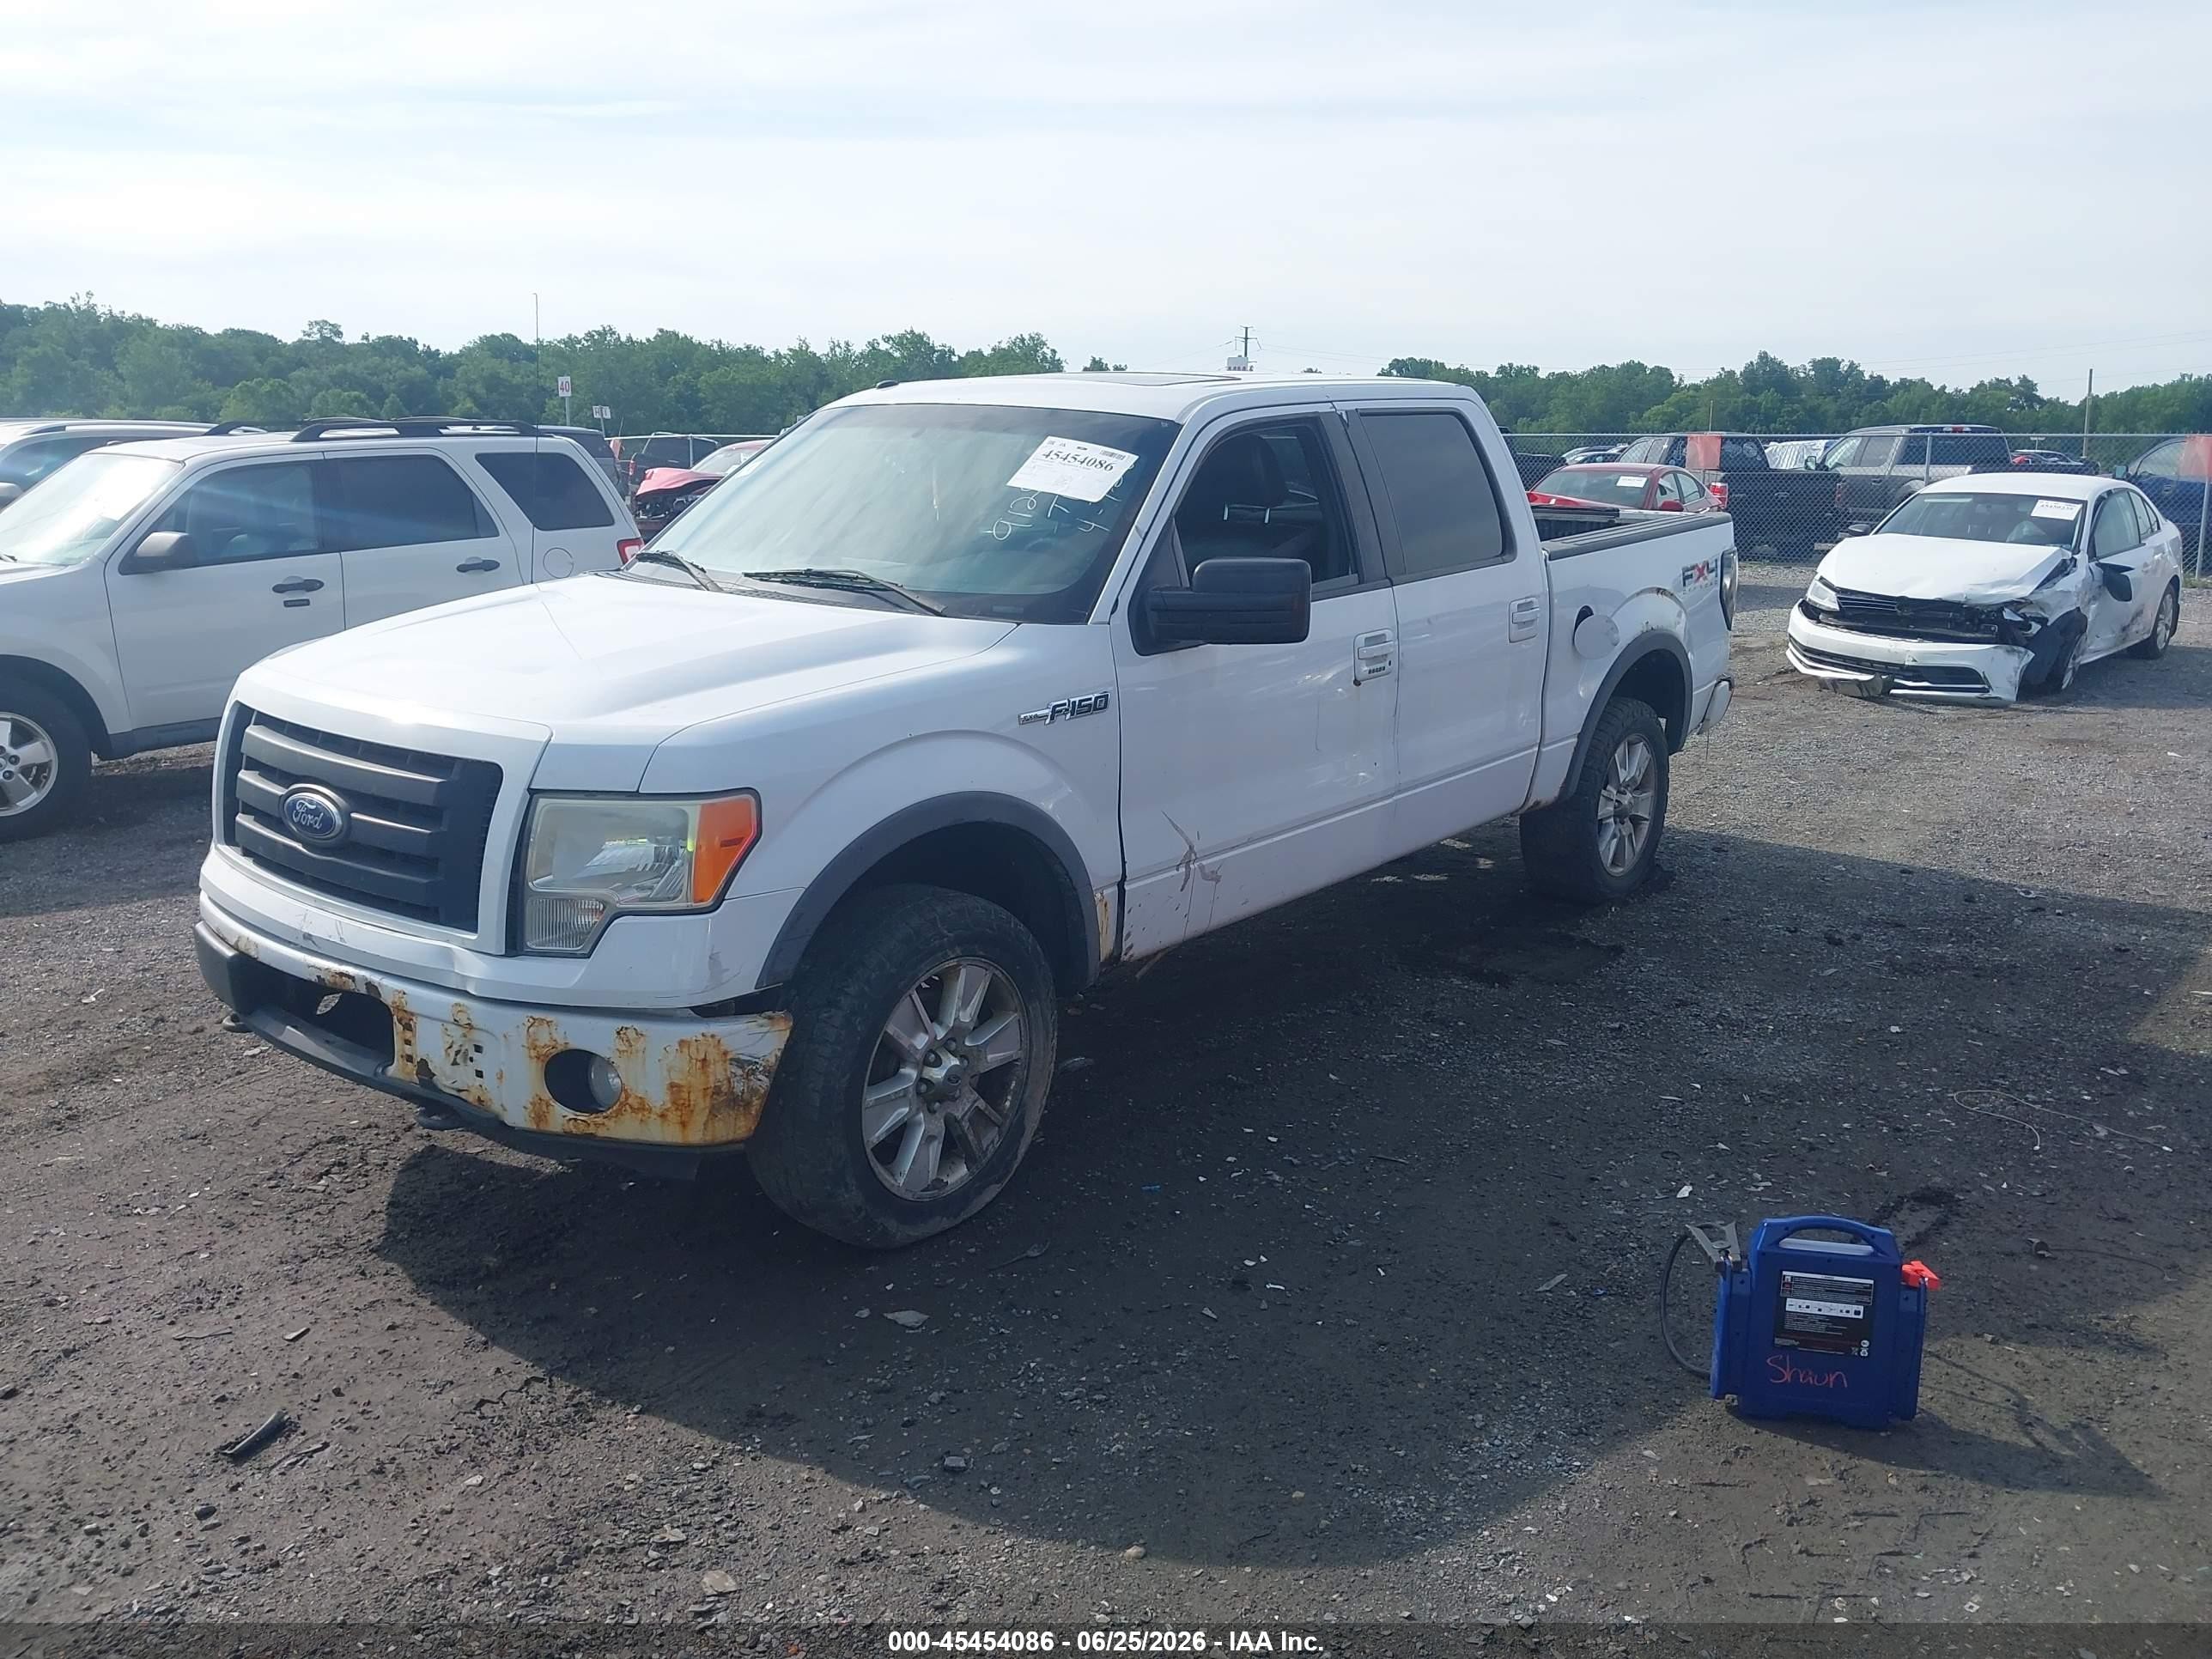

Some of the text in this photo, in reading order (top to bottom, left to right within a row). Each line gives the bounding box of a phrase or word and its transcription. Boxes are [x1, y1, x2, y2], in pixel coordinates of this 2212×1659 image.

[559, 380, 570, 392] 40
[1042, 449, 1115, 472] 45454086
[1681, 559, 1718, 587] FX4
[292, 799, 324, 830] Ford
[1766, 1354, 1848, 1389] Shaun
